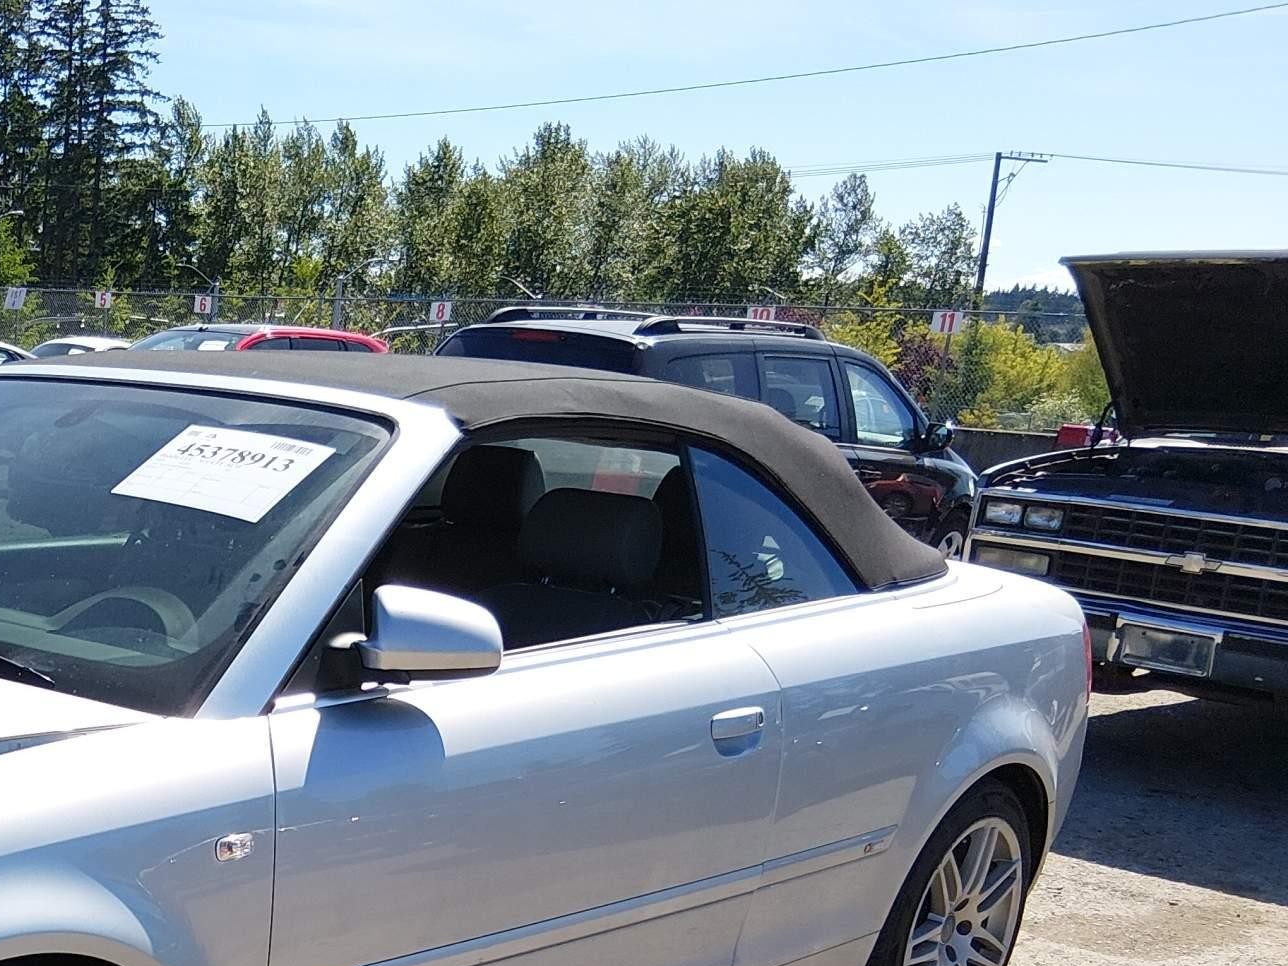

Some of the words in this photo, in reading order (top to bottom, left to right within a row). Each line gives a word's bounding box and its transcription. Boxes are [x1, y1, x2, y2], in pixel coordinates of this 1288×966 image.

[100, 292, 107, 308] 5
[199, 297, 207, 312] 6
[436, 303, 446, 320] 8
[940, 312, 956, 333] 11
[176, 442, 295, 473] 45378913
